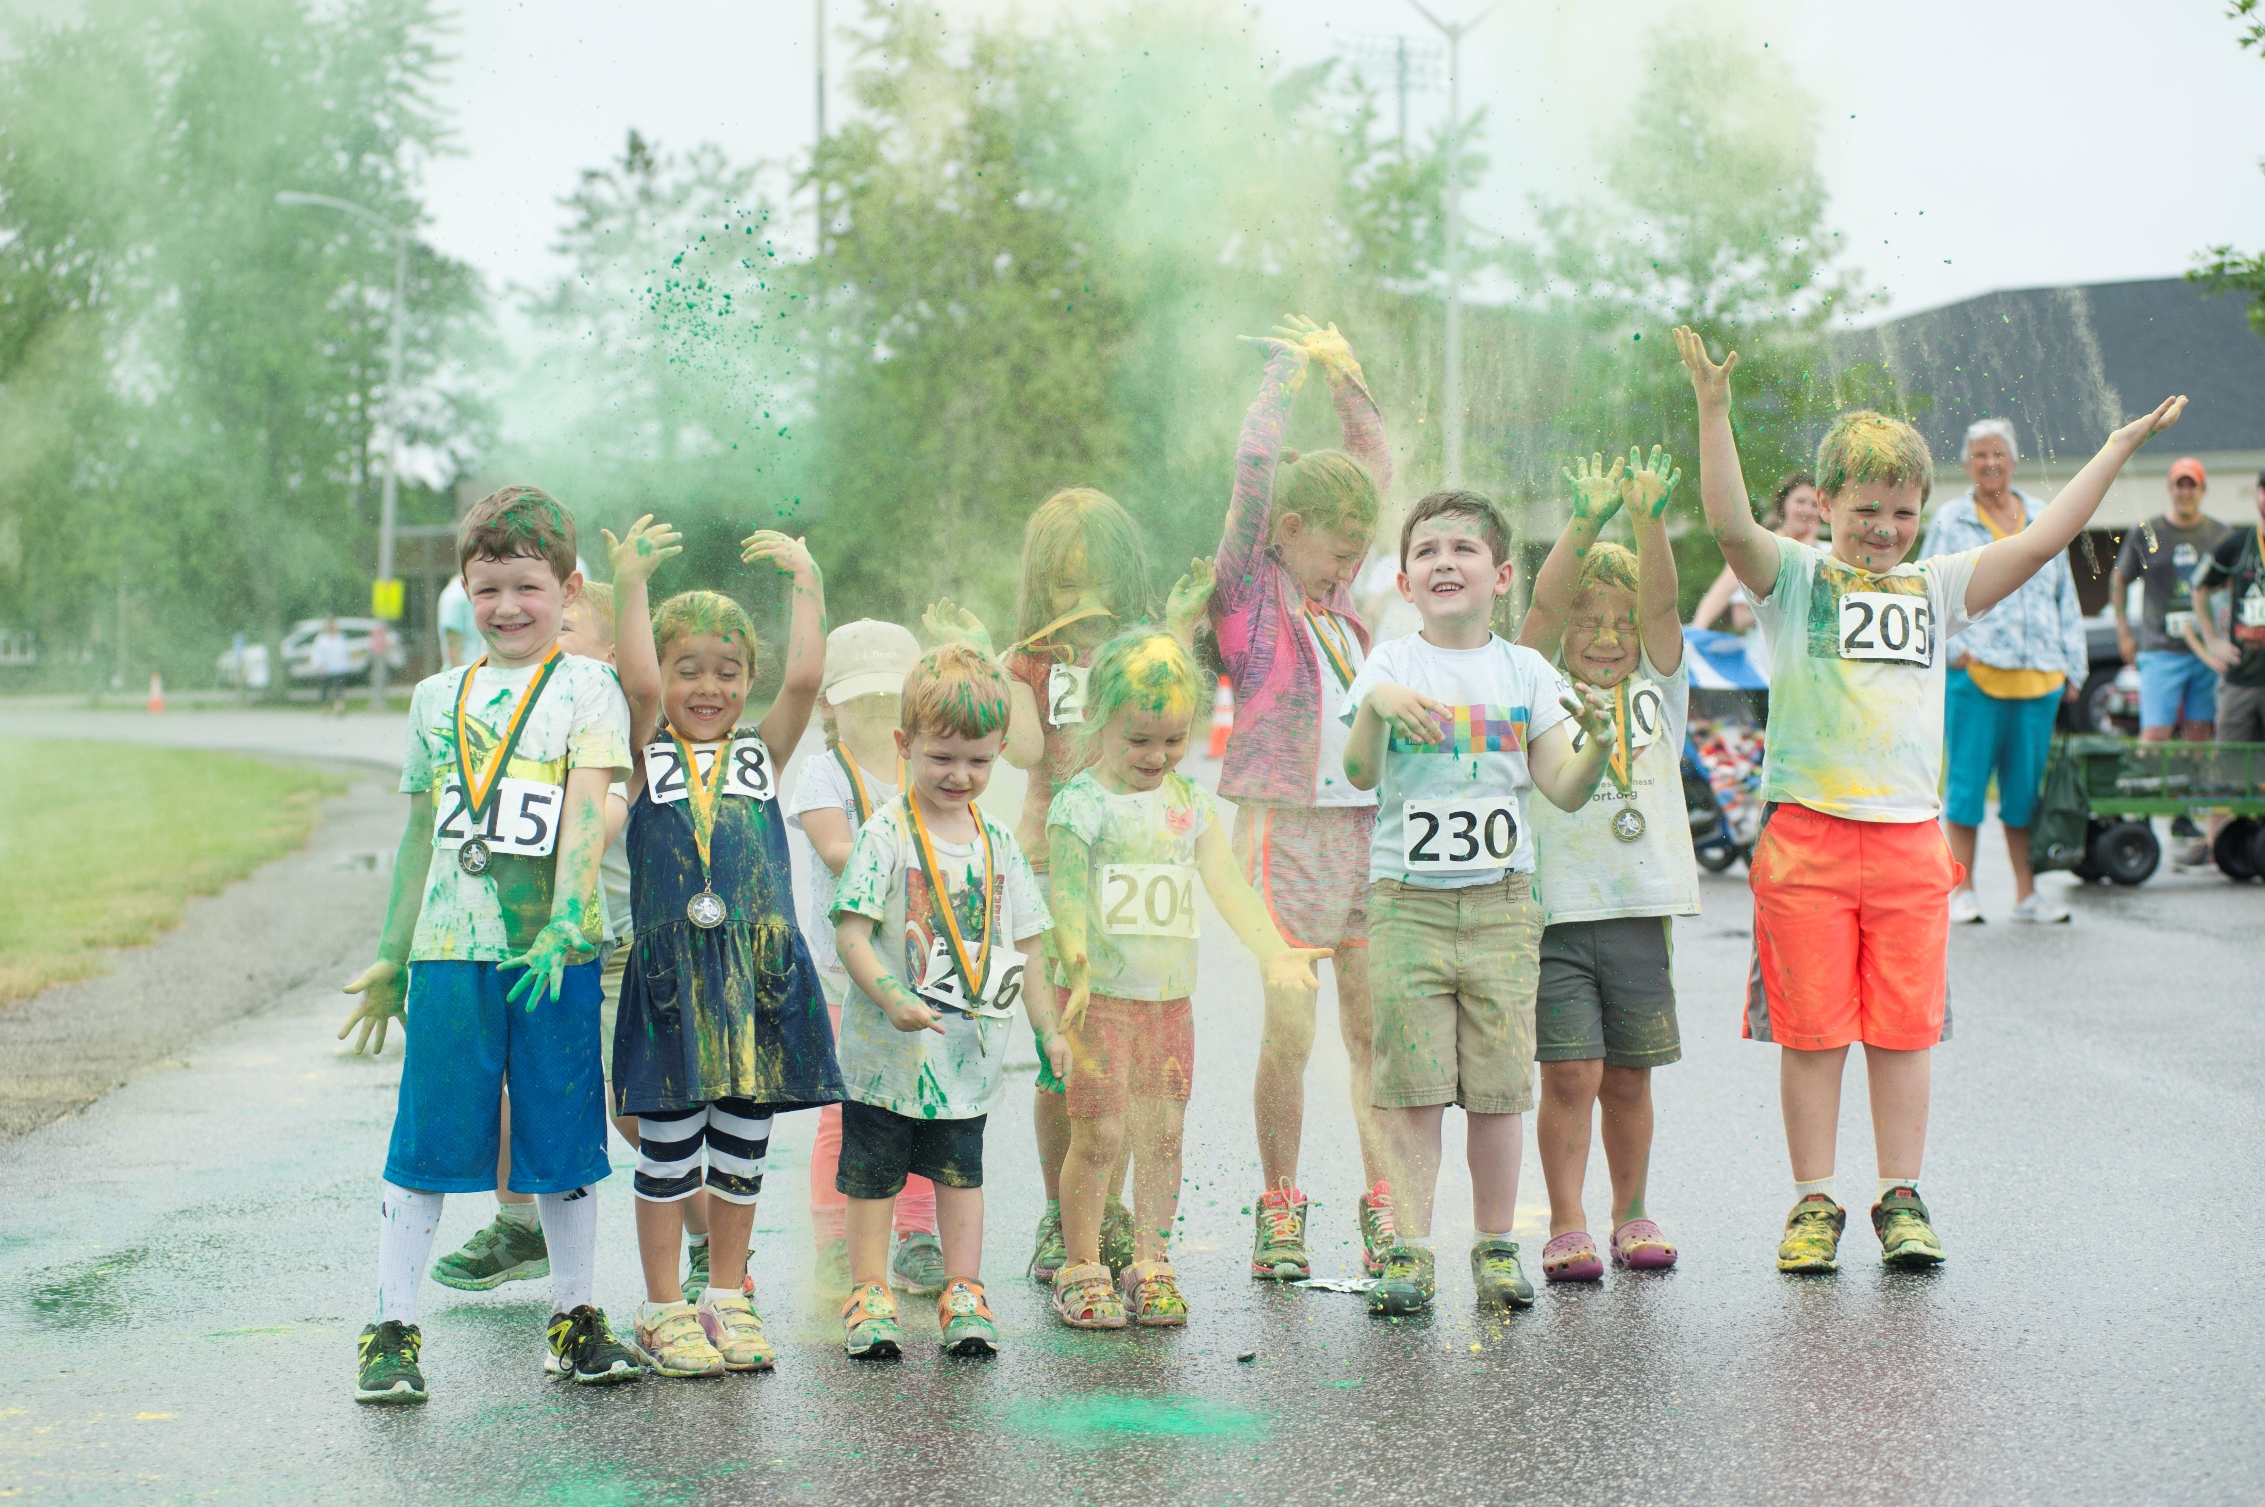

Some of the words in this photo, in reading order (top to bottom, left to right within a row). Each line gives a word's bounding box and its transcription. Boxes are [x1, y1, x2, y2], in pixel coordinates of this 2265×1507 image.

[1844, 602, 1928, 655] 205
[854, 651, 897, 661] L.L.Bean
[651, 747, 768, 794] 228
[438, 785, 552, 846] 215
[1408, 808, 1518, 862] 230
[1106, 874, 1195, 929] 204
